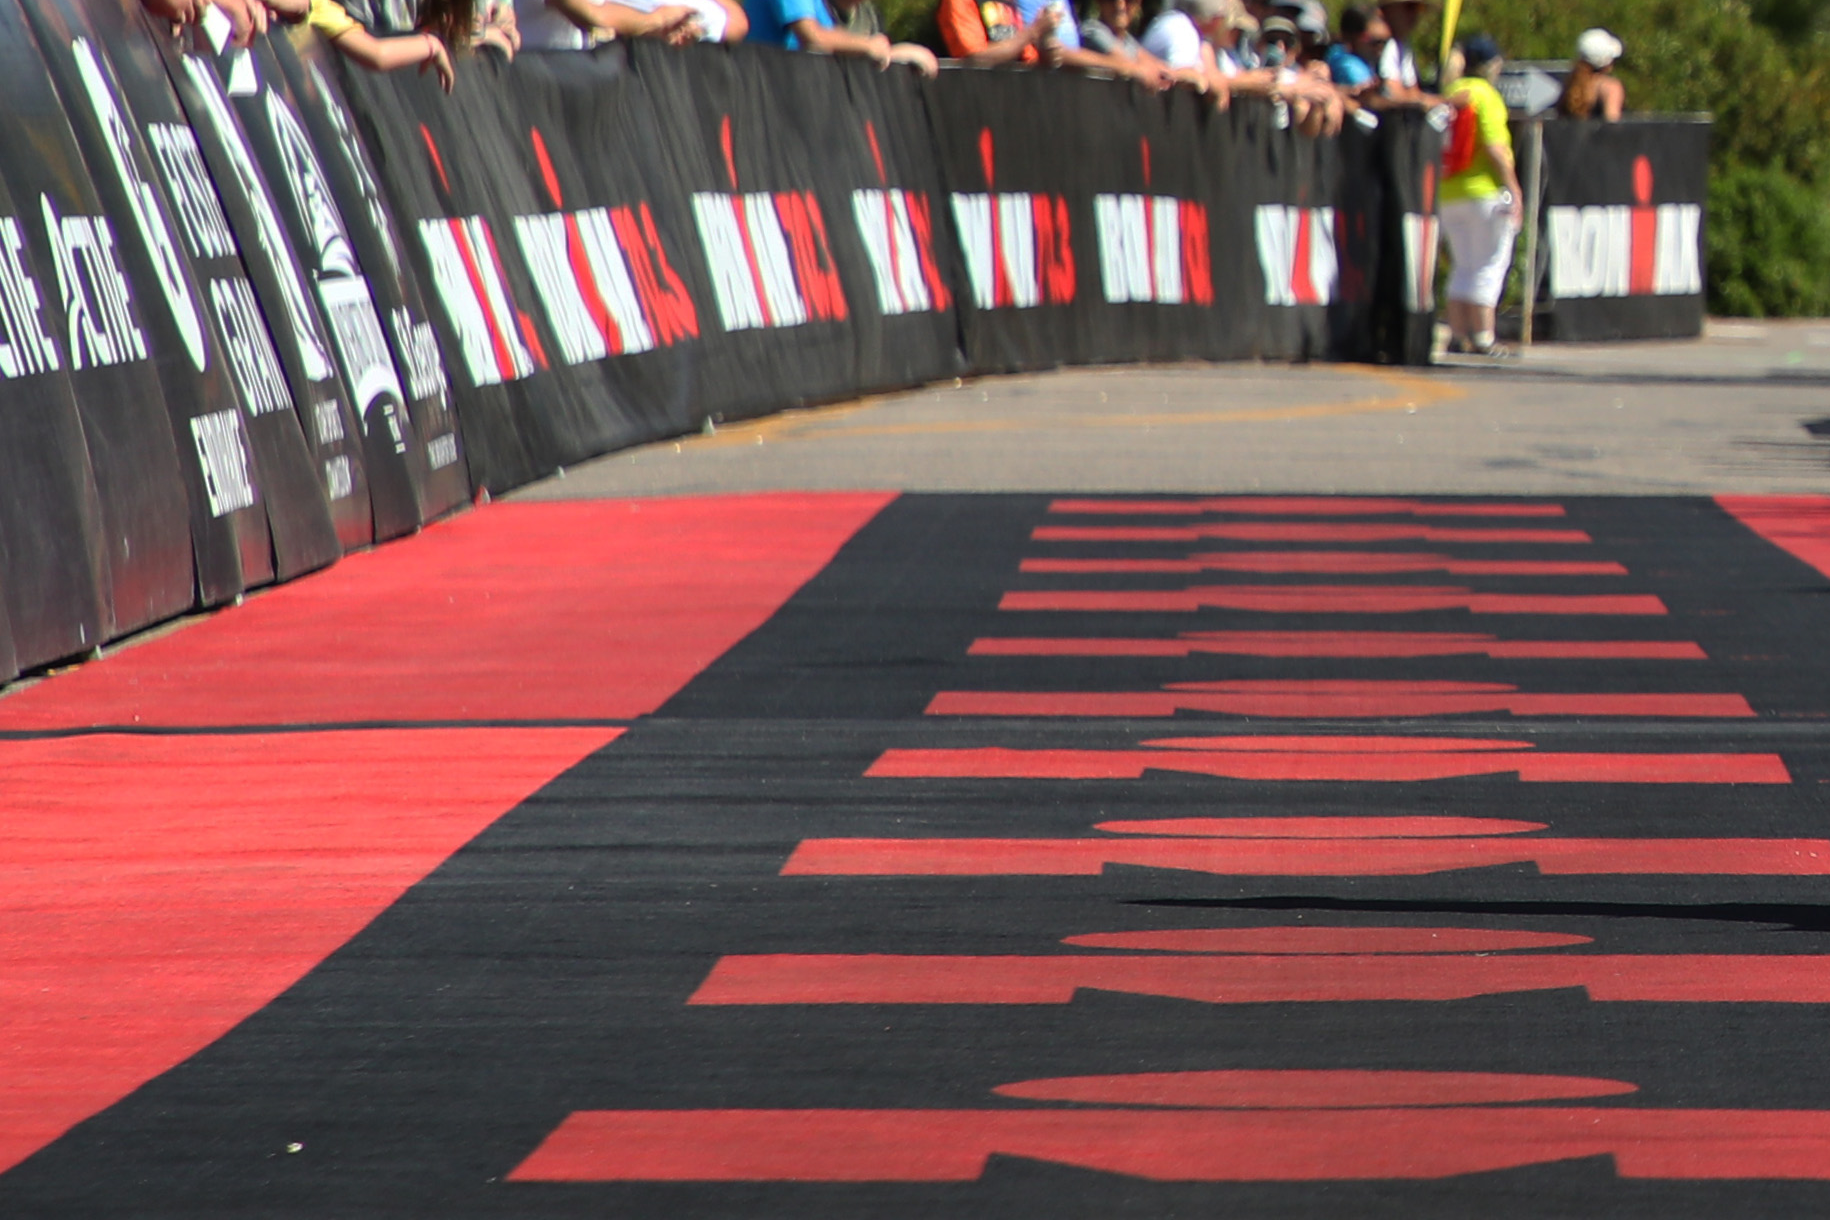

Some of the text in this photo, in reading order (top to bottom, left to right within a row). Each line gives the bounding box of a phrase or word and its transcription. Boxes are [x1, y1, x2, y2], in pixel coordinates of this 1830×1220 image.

[149, 123, 238, 257] FOSTE
[41, 191, 148, 371] ACTIVE
[211, 276, 293, 417] GRAN
